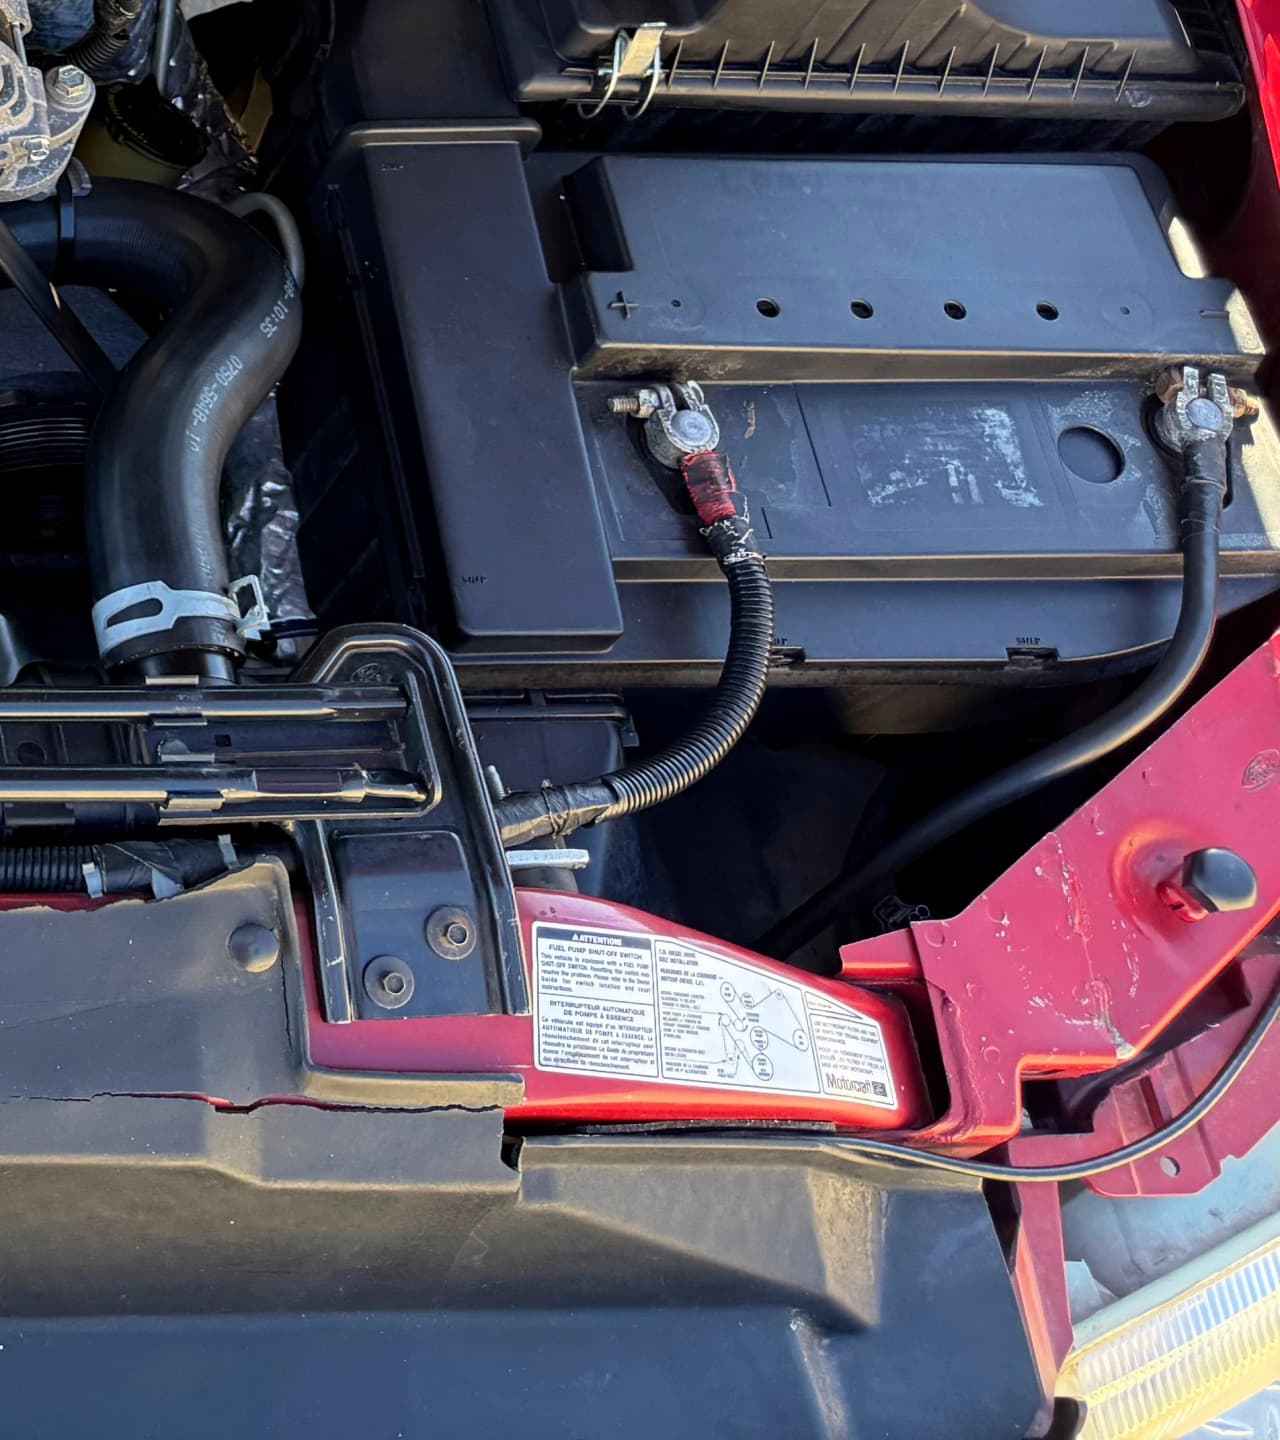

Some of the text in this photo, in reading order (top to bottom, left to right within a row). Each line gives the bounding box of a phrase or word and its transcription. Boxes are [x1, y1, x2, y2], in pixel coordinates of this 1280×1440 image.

[549, 944, 566, 952] FUEL
[588, 948, 618, 957] SHUT-OFF
[619, 950, 642, 960] SWITCH
[550, 1000, 645, 1016] INTERRUPTEUR AUTOMATIQUE
[575, 1011, 597, 1019] POMPE
[606, 1013, 634, 1022] ESSENCE
[825, 1072, 872, 1094] Motorcraft
